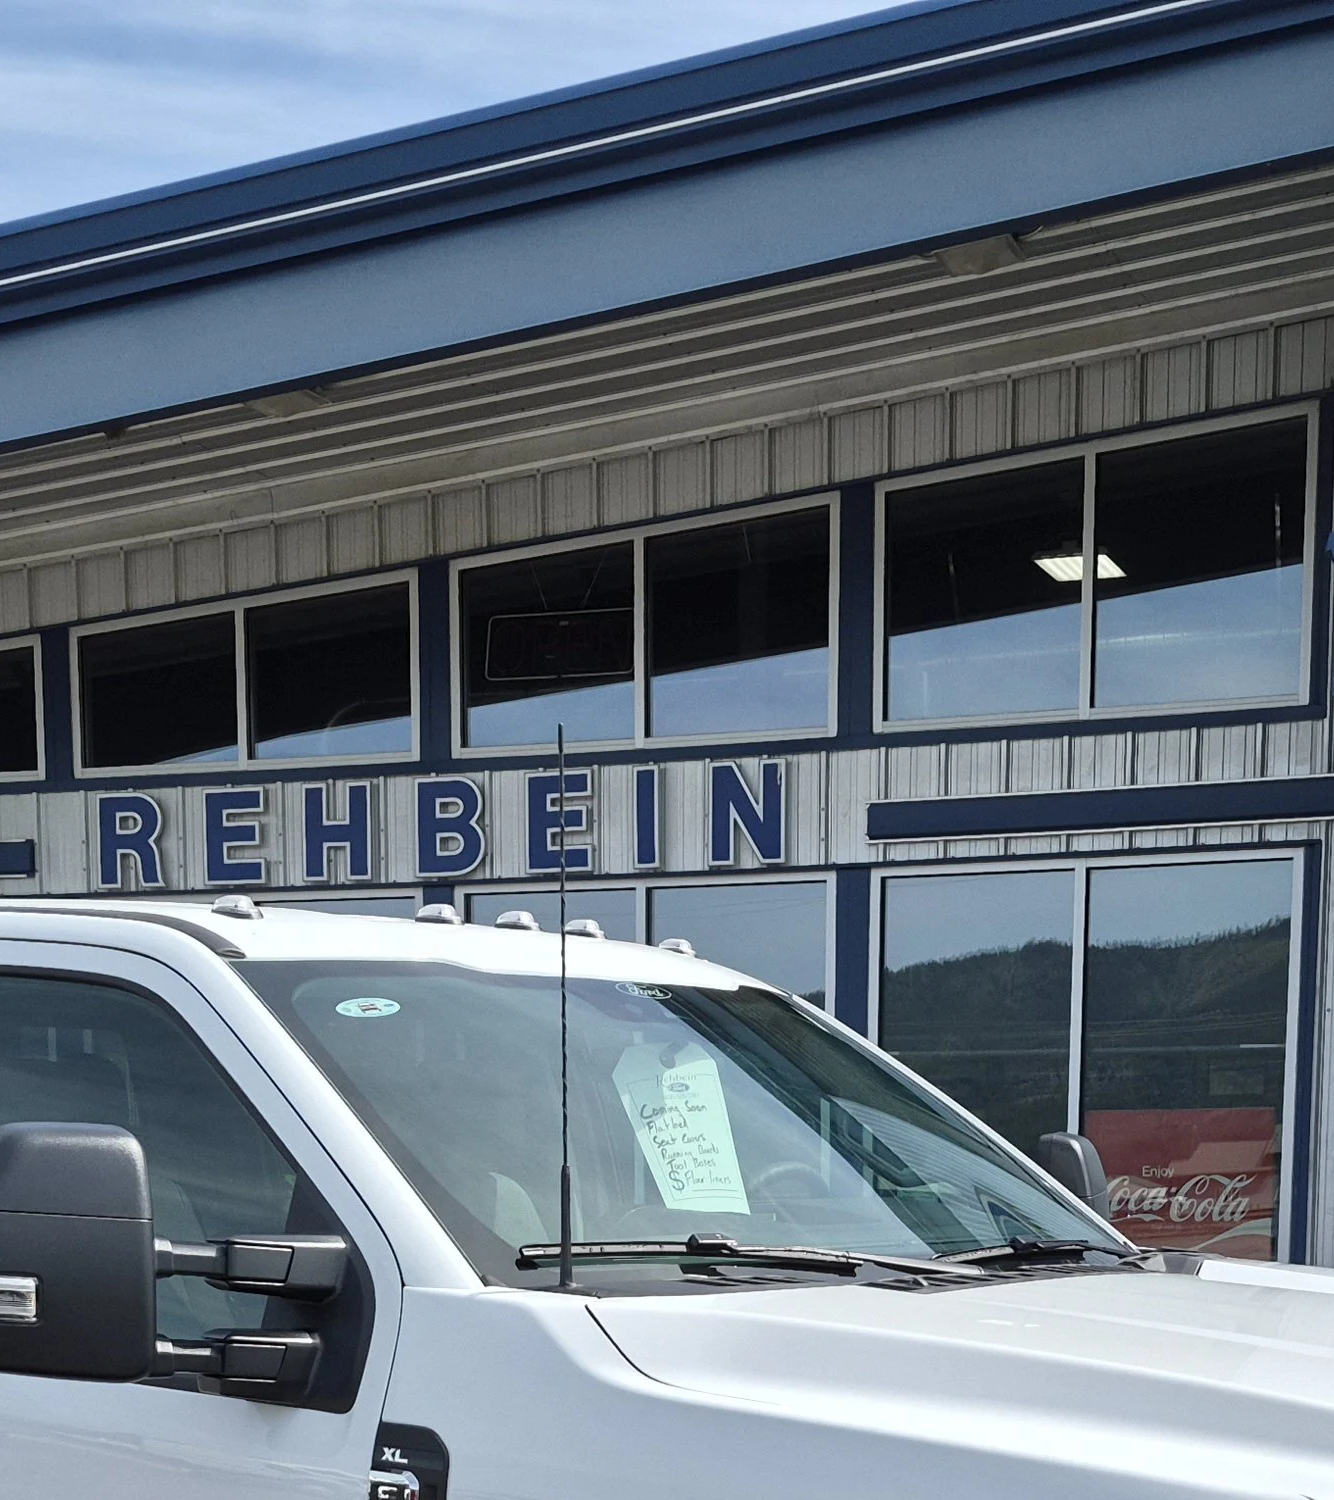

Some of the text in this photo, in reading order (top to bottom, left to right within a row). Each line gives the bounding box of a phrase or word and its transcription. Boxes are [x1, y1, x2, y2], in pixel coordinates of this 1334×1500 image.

[95, 759, 789, 890] REHBEIN
[640, 1100, 707, 1120] Coming Soon
[653, 1132, 676, 1148] Seat
[661, 1148, 694, 1161] Running
[667, 1157, 716, 1170] Tool Boxes
[1142, 1165, 1174, 1178] Enjoy
[668, 1170, 685, 1194] $
[381, 1447, 409, 1464] XL
